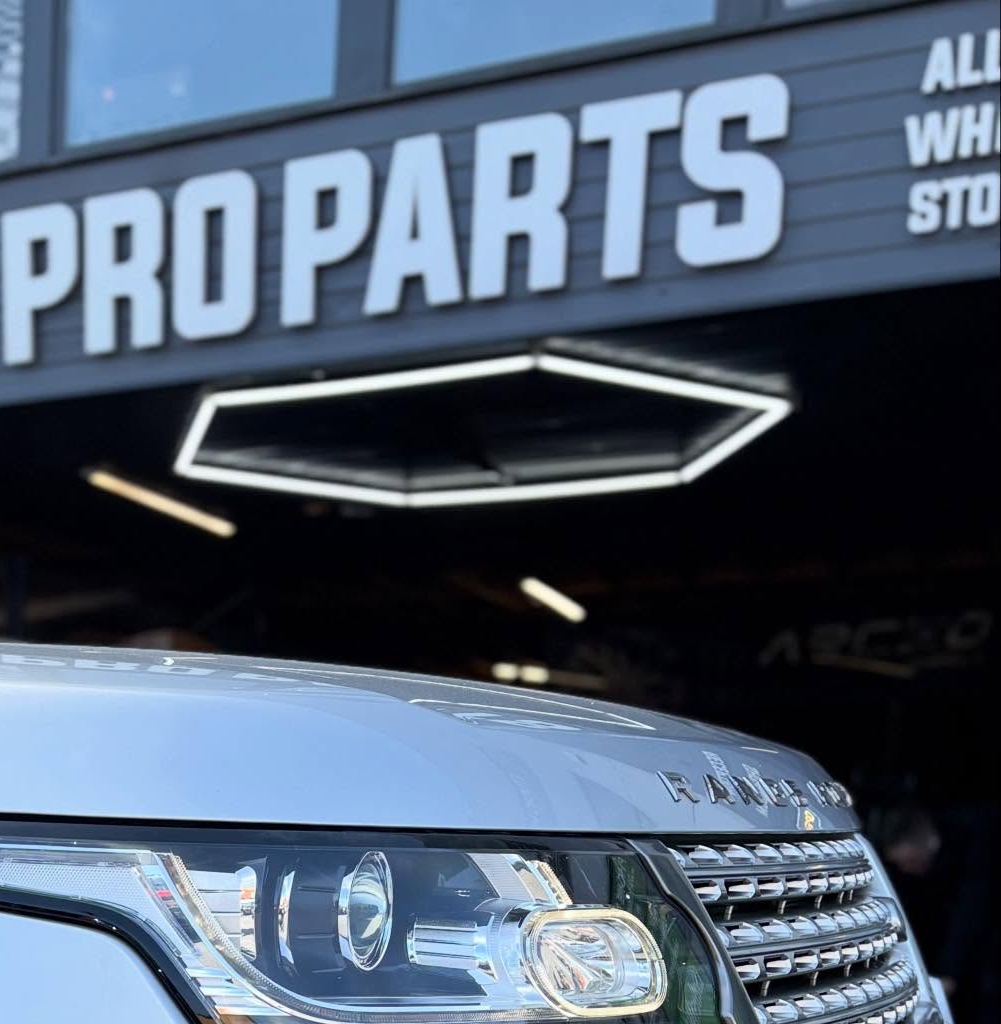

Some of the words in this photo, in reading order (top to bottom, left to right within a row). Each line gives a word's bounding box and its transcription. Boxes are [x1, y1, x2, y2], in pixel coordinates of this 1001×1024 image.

[920, 28, 1000, 95] ALL
[904, 102, 1000, 168] WH
[0, 169, 258, 367] PRO
[280, 73, 790, 329] PARTS
[656, 770, 809, 807] RANGE
